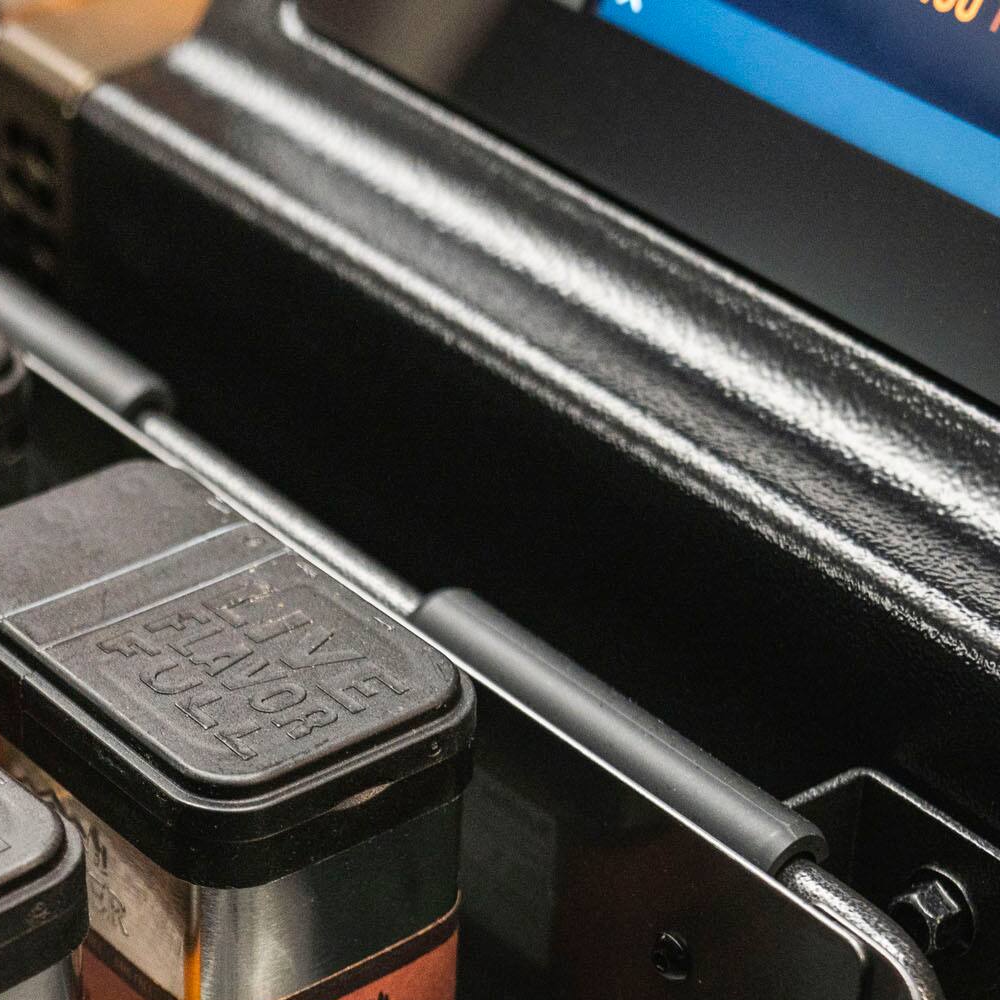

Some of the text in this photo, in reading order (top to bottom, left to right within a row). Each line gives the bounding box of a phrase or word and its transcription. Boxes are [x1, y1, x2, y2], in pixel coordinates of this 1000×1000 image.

[96, 630, 262, 762] FULL
[143, 612, 339, 741] FLAVOR
[202, 584, 411, 716] LIVE
